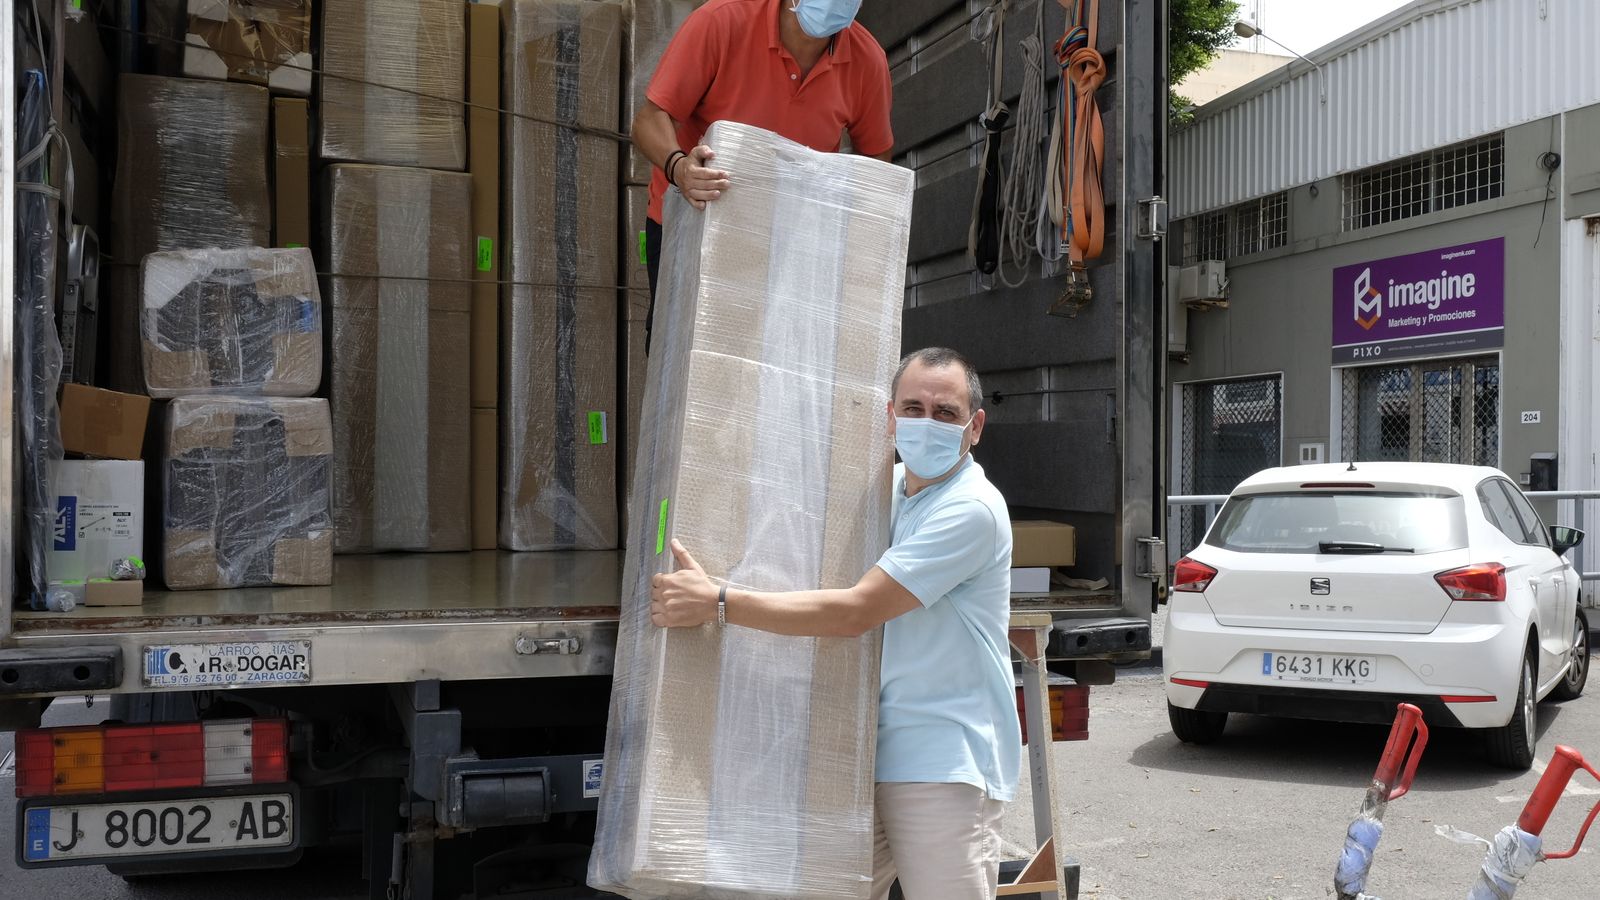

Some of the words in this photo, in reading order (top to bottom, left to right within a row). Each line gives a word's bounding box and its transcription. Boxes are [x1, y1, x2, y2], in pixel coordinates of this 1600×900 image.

[1388, 270, 1476, 310] imagine
[1388, 315, 1421, 328] Marketing
[1422, 315, 1427, 326] y
[1428, 309, 1476, 323] Promociones
[1353, 345, 1381, 358] PIXO
[1523, 413, 1538, 422] 204
[209, 645, 295, 657] CARROCIAS
[164, 650, 305, 675] CRDOGAR
[1276, 656, 1323, 675] 6431
[1332, 658, 1370, 677] KKG
[195, 674, 207, 683] 52
[211, 673, 222, 682] 76
[248, 671, 305, 681] ZARAGOZA
[53, 812, 79, 852] J
[105, 805, 212, 848] 8002
[236, 800, 287, 840] AB
[33, 840, 44, 851] E
